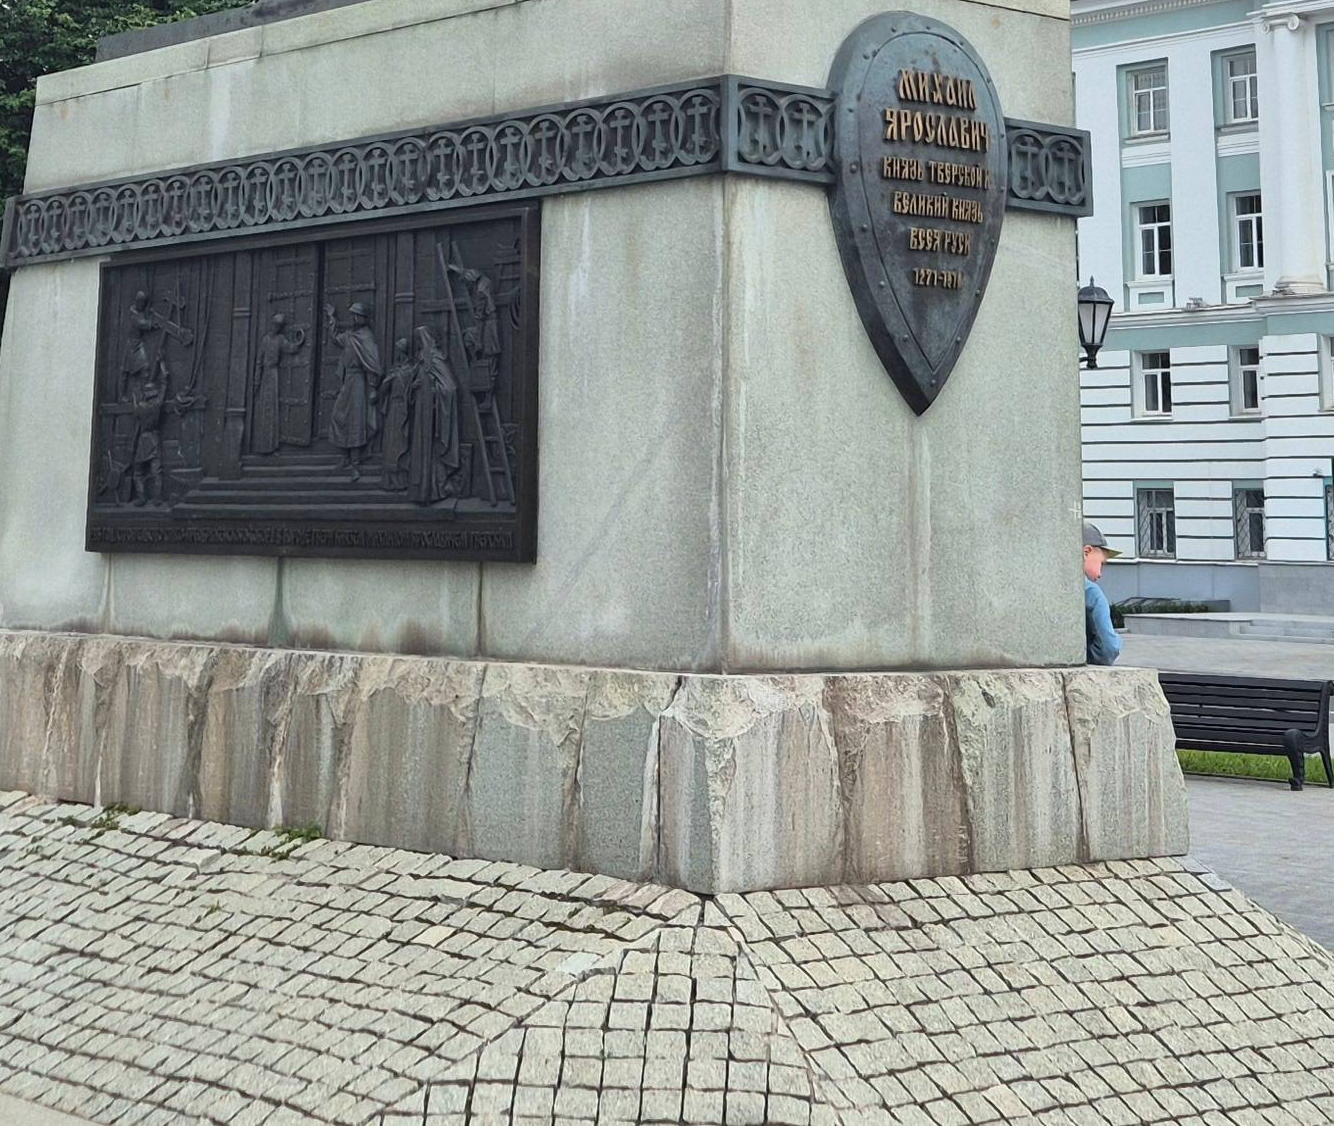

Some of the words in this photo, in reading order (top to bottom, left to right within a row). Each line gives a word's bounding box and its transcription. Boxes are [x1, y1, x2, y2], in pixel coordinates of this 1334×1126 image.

[897, 68, 977, 110] МИХАИЛ
[884, 107, 989, 153] ЯРОСЛАВИЧ
[882, 156, 924, 181] КНЯЗЬ
[928, 160, 983, 189] ТВЕРСКОЙ
[893, 190, 949, 218] ВЕЛИКИЙ
[951, 197, 984, 224] КНЯЗЬ
[909, 226, 941, 251] ВСЕЯ
[944, 229, 972, 257] РУСИ
